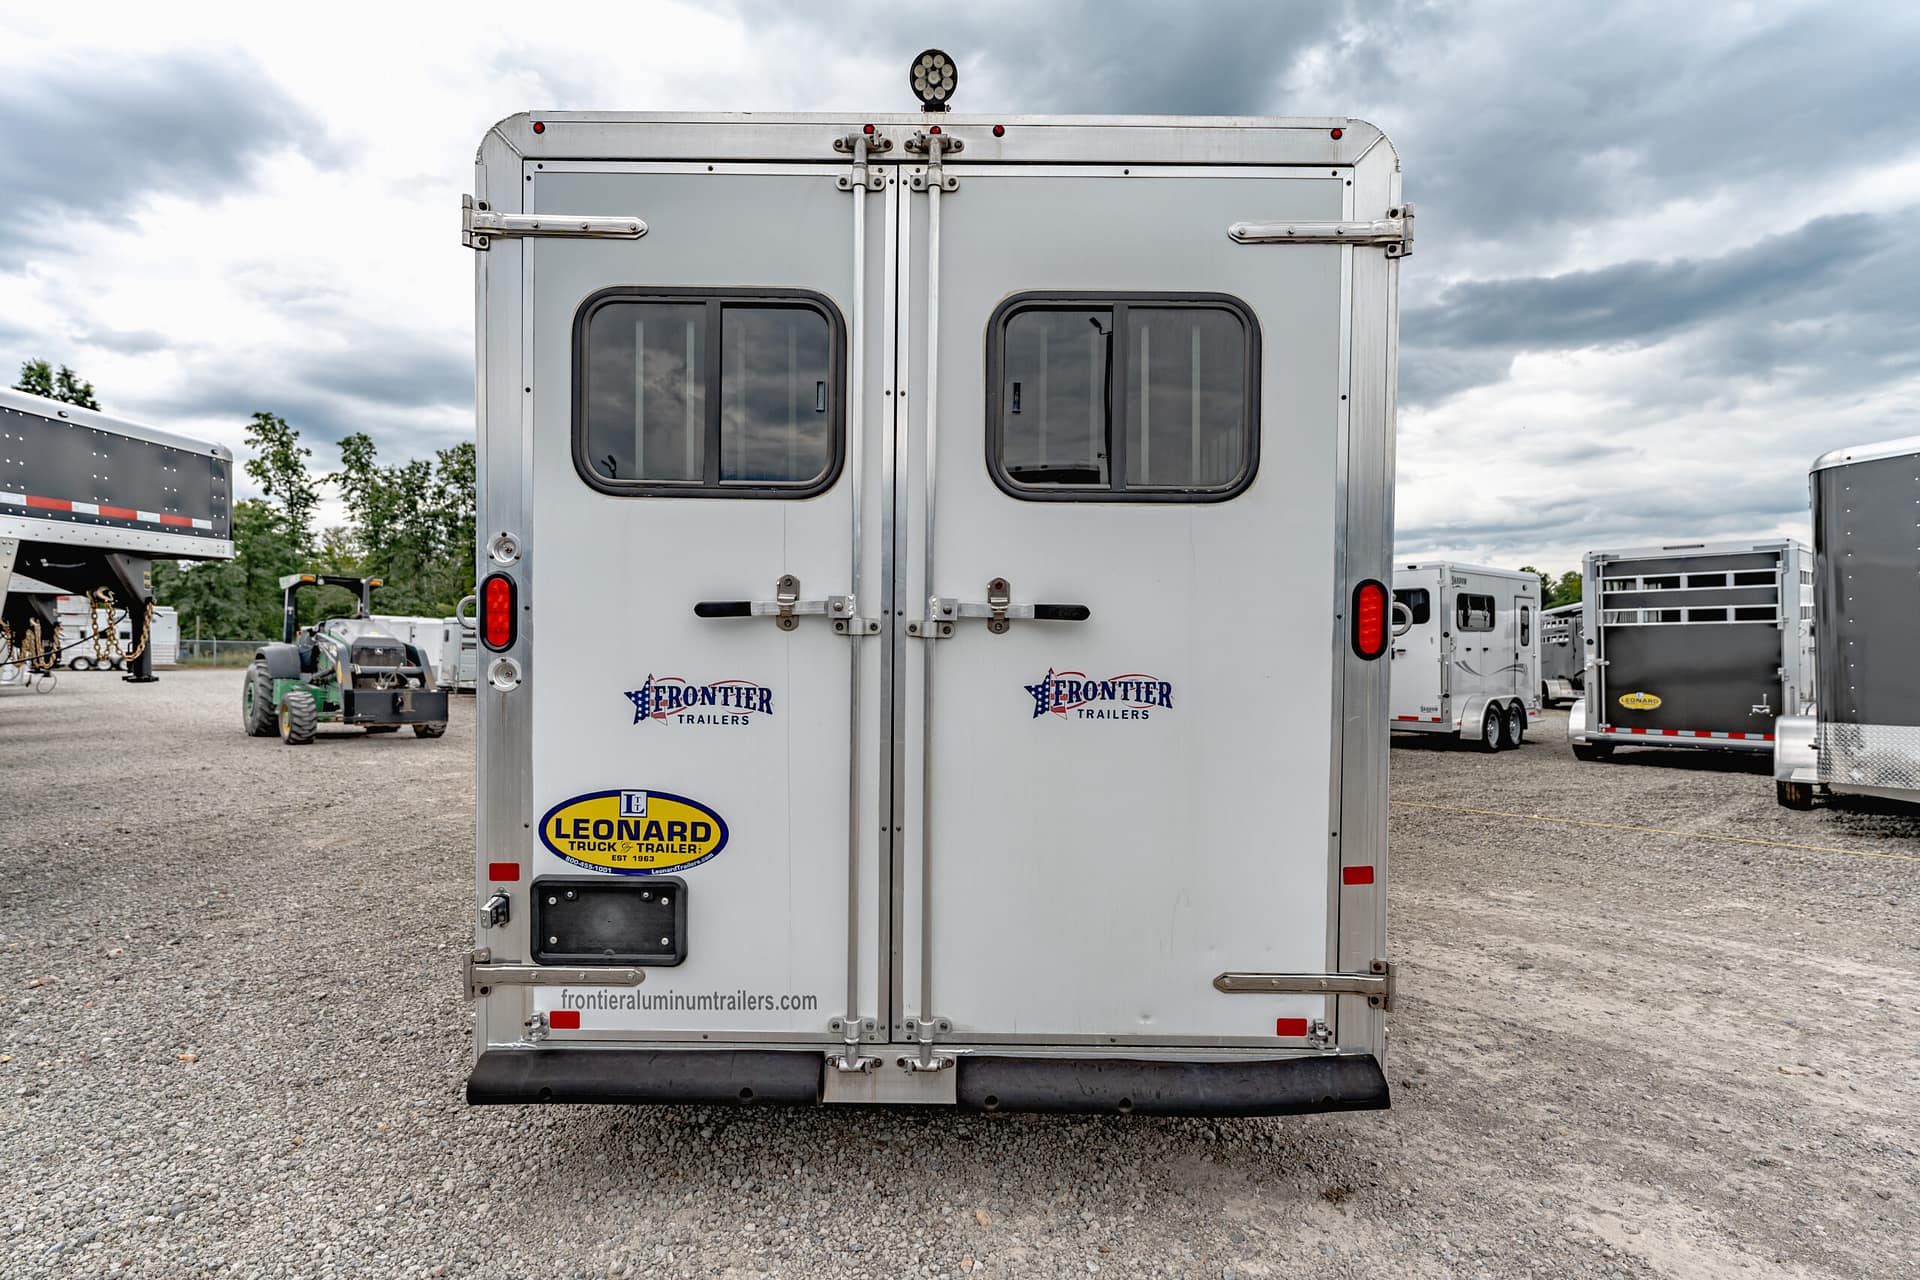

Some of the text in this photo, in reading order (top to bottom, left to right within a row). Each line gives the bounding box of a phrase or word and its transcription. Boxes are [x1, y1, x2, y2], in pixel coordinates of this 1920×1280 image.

[653, 685, 773, 715] FRONTIER
[1053, 680, 1173, 709] FRONTIER
[677, 714, 750, 725] TRAILERS
[1077, 709, 1150, 720] TRAILERS
[555, 818, 712, 842] LEONARD
[568, 841, 617, 852] TRUCK
[636, 842, 697, 854] TRAILER
[561, 989, 817, 1011] frontieraluminumtrailers.com
